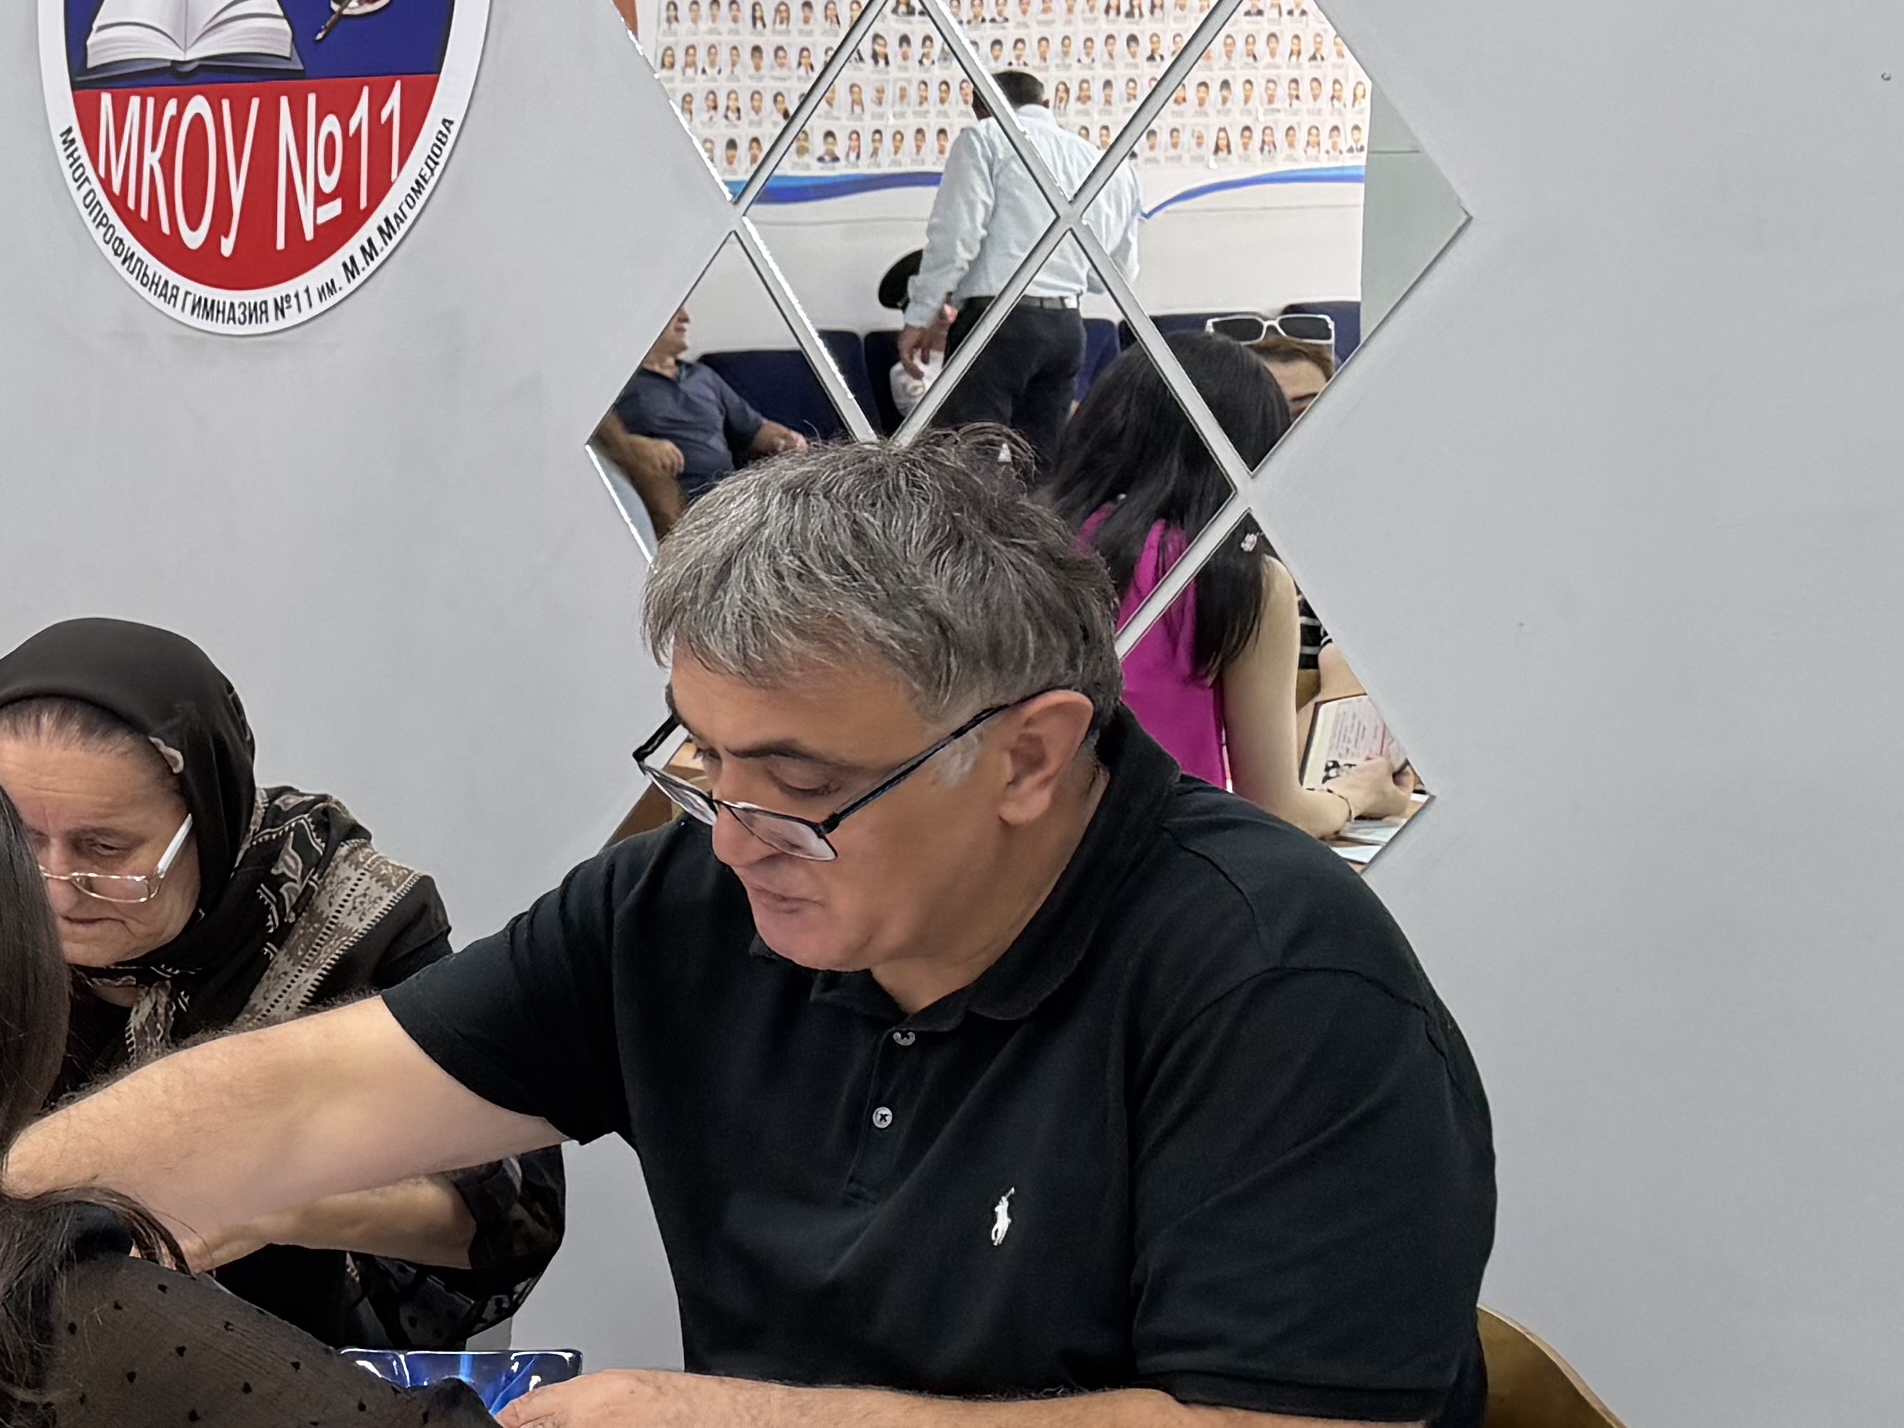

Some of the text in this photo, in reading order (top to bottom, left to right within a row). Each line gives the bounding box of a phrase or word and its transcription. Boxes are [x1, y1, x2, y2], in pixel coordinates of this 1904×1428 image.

[59, 125, 181, 309] МНОГОПРОФИЛЬНАЯ
[181, 290, 270, 326] ГИМНАЗИЯ
[98, 79, 406, 259] МКОУ №11
